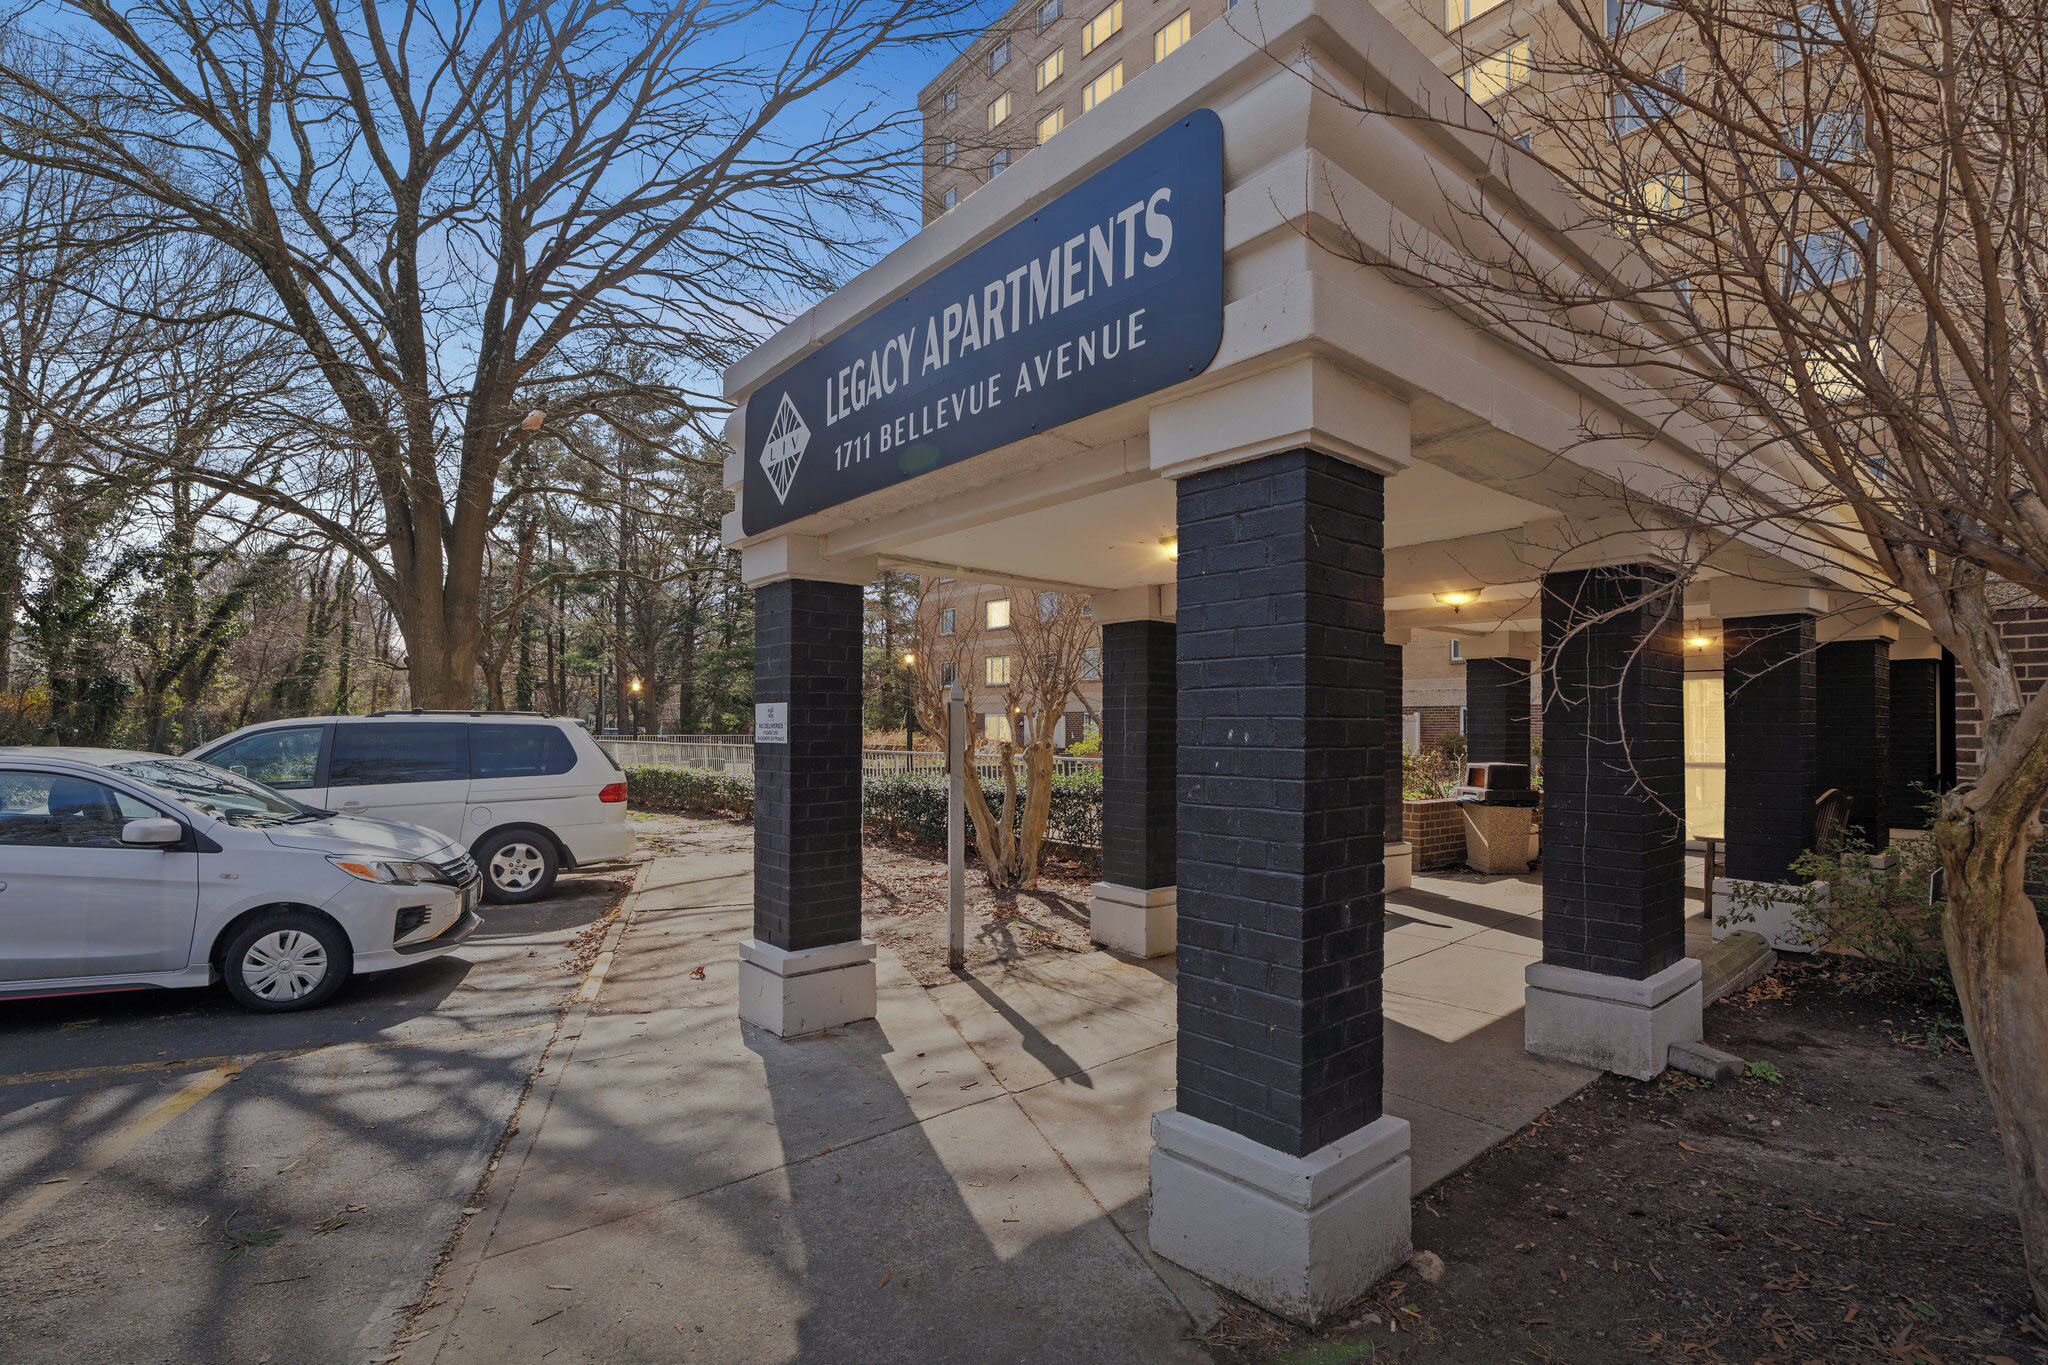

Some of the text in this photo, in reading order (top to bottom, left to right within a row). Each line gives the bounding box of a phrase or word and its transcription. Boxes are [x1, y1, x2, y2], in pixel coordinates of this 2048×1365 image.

[826, 187, 1173, 427] LEGACY APARTMENTS
[769, 432, 801, 462] LIV
[834, 308, 1147, 472] 1711 BELLEVUE AVENUE
